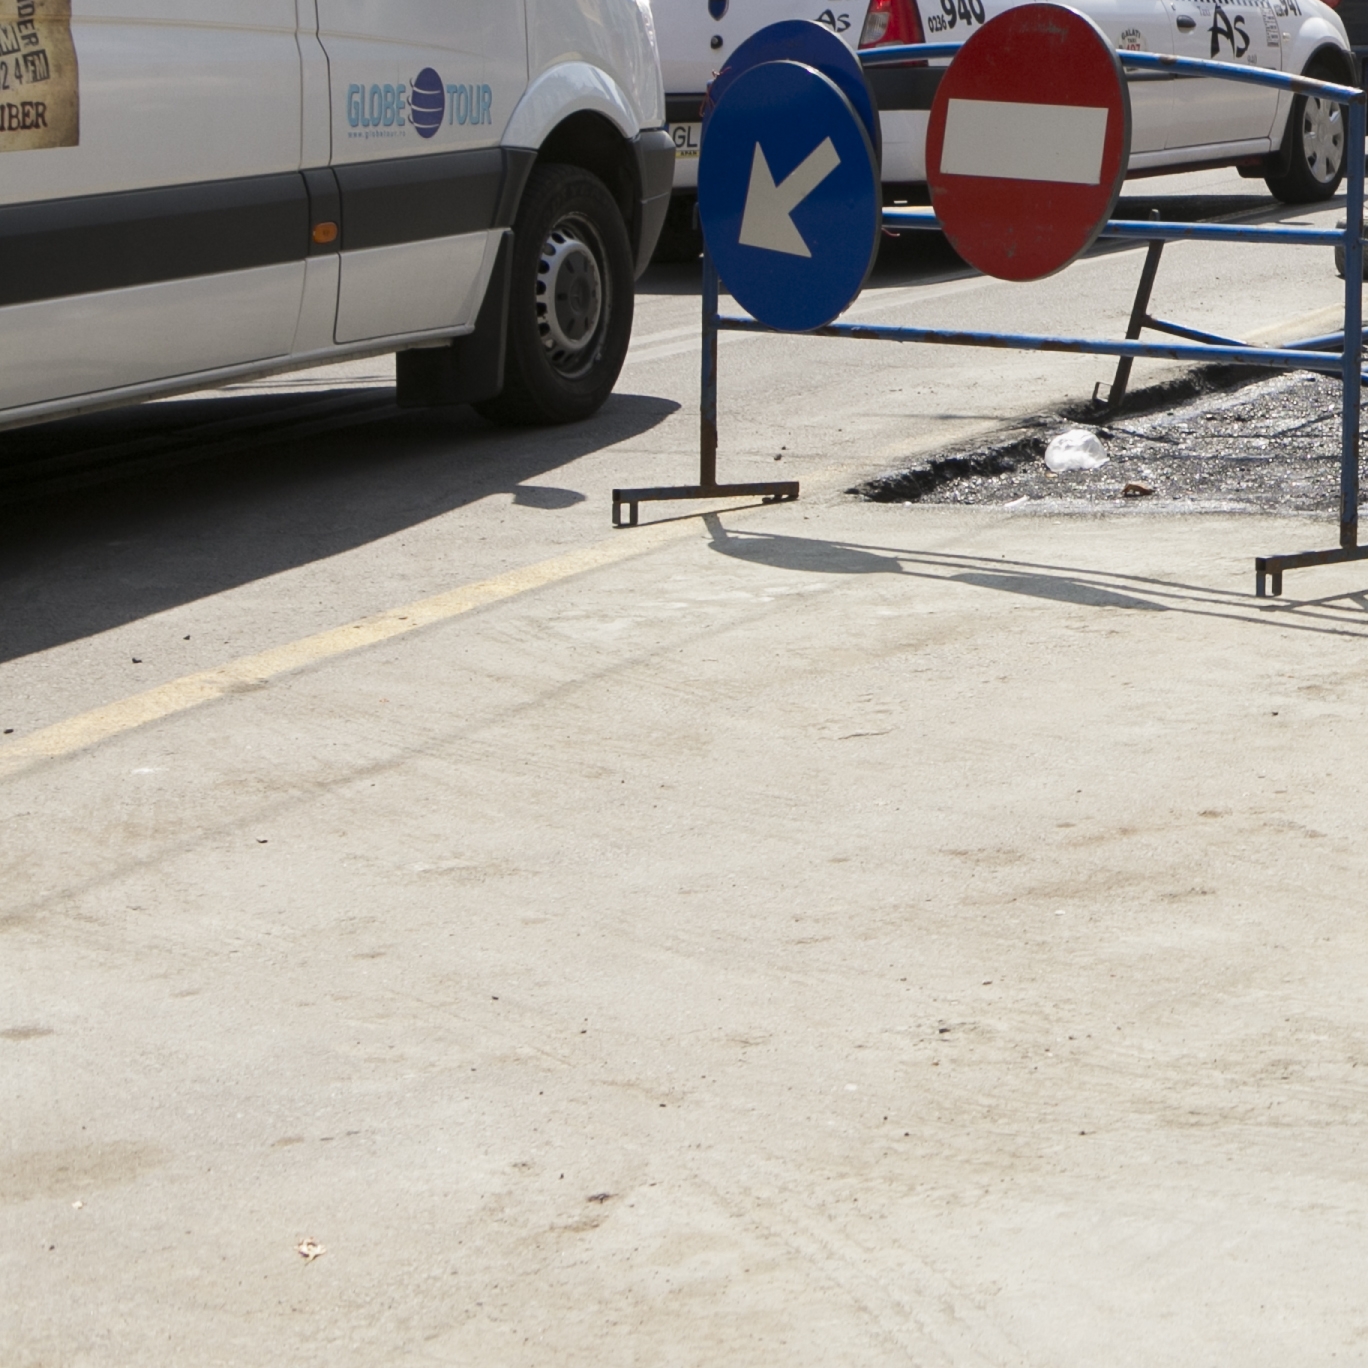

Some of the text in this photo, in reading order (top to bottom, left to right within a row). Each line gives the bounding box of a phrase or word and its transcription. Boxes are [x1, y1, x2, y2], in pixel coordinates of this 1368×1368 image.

[928, 14, 947, 33] 0236
[1207, 3, 1250, 60] As
[347, 84, 493, 127] GLOBE TOUR
[673, 126, 698, 148] GL
